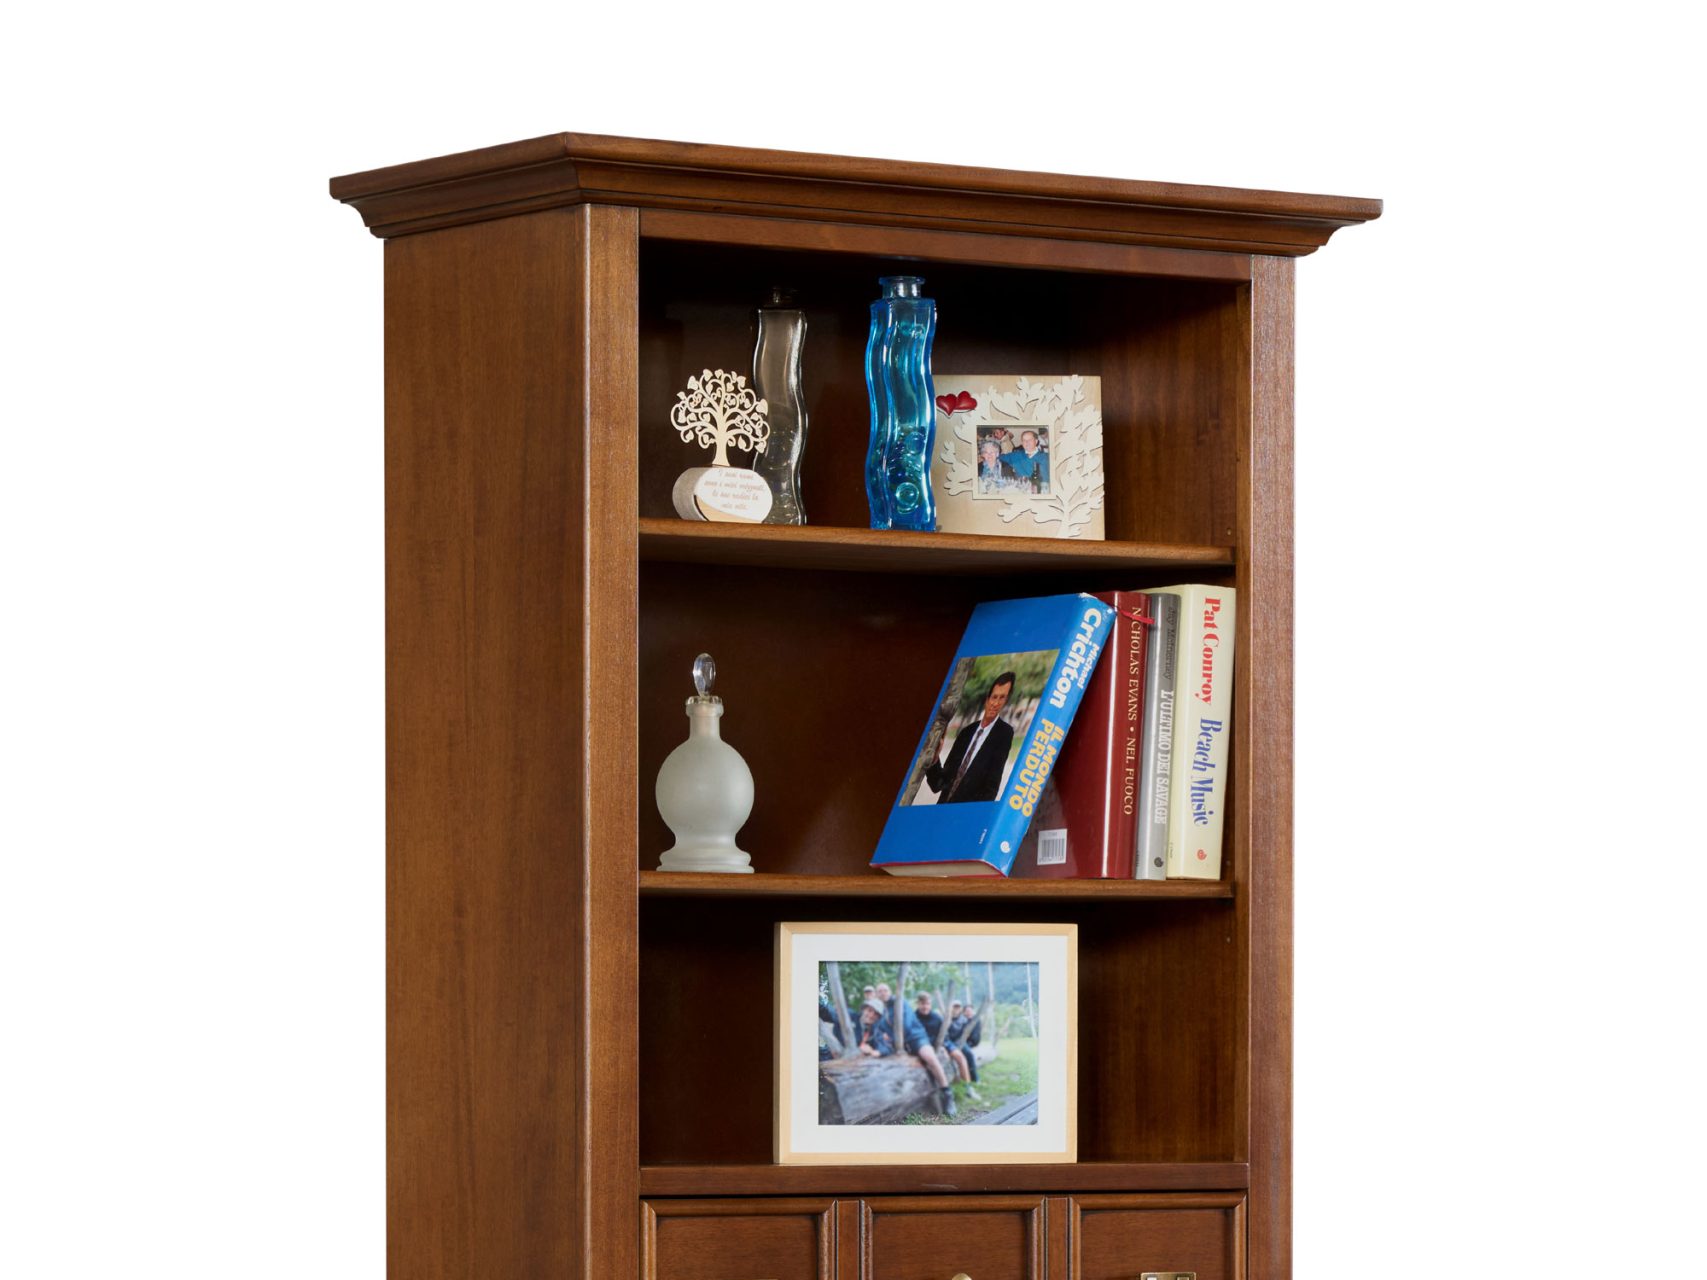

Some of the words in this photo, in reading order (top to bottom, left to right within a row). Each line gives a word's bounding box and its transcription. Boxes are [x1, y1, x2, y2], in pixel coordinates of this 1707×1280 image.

[1203, 597, 1222, 630] Pat
[1048, 606, 1103, 710] Crichton
[1076, 641, 1101, 690] Michael
[1128, 606, 1142, 676] NCHOLAS
[1194, 633, 1222, 707] Conroy
[1127, 678, 1140, 722] EVANS
[1157, 689, 1174, 752] L'ULTIMO
[1054, 725, 1067, 742] IL
[1125, 736, 1137, 765] NEL
[1193, 717, 1223, 770] Beach
[1008, 718, 1056, 811] PERDUTO
[1021, 741, 1057, 818] MONDO
[1156, 753, 1171, 775] DEI
[1122, 767, 1136, 816] FUOCO
[1153, 776, 1170, 825] SAVAGE
[1189, 773, 1215, 826] Music
